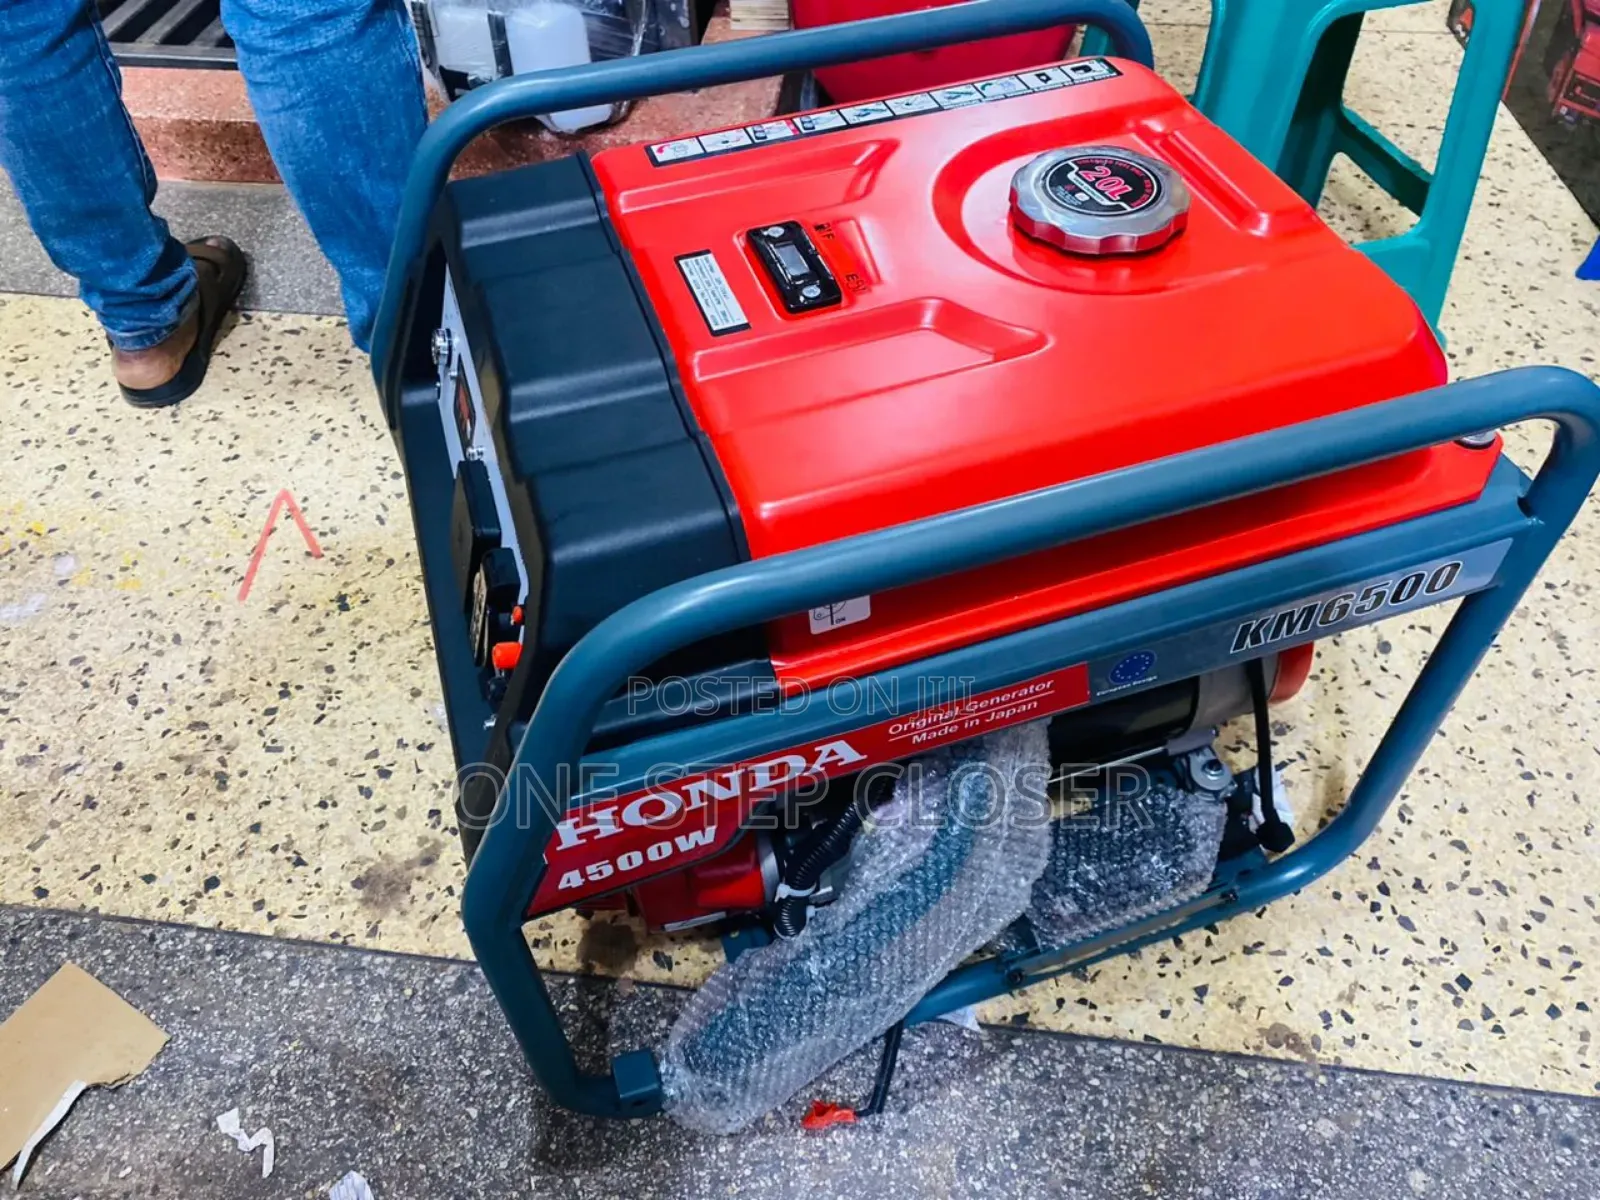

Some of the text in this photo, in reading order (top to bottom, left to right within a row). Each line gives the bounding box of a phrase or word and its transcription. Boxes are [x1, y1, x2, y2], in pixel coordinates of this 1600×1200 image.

[1077, 166, 1133, 201] 20L
[1229, 560, 1463, 654] KM6500
[888, 679, 1055, 736] Original Generator
[911, 700, 1038, 744] Made in Japan
[555, 739, 868, 851] HONDA
[557, 825, 718, 890] 4500W
